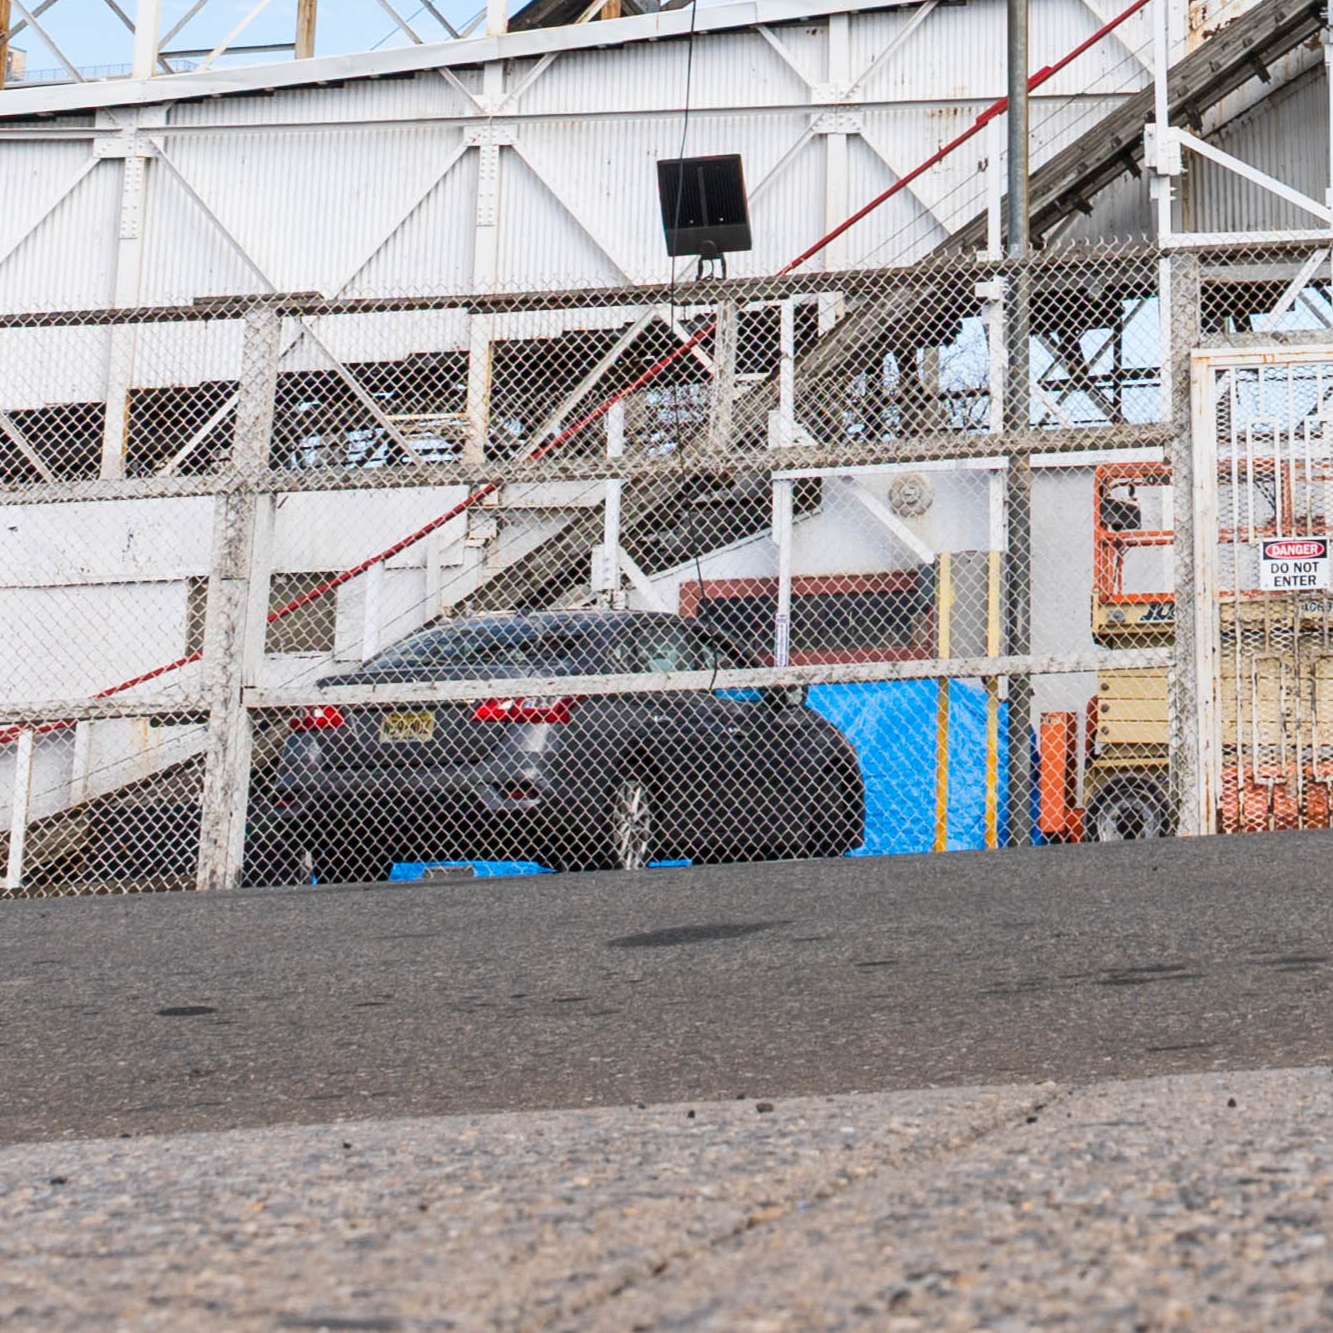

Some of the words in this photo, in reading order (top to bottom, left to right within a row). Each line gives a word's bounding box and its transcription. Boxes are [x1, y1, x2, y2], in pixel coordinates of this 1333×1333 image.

[1271, 543, 1319, 556] DANGER
[1270, 562, 1290, 574] DO
[1293, 561, 1319, 573] NOT
[1273, 574, 1317, 587] ENTER
